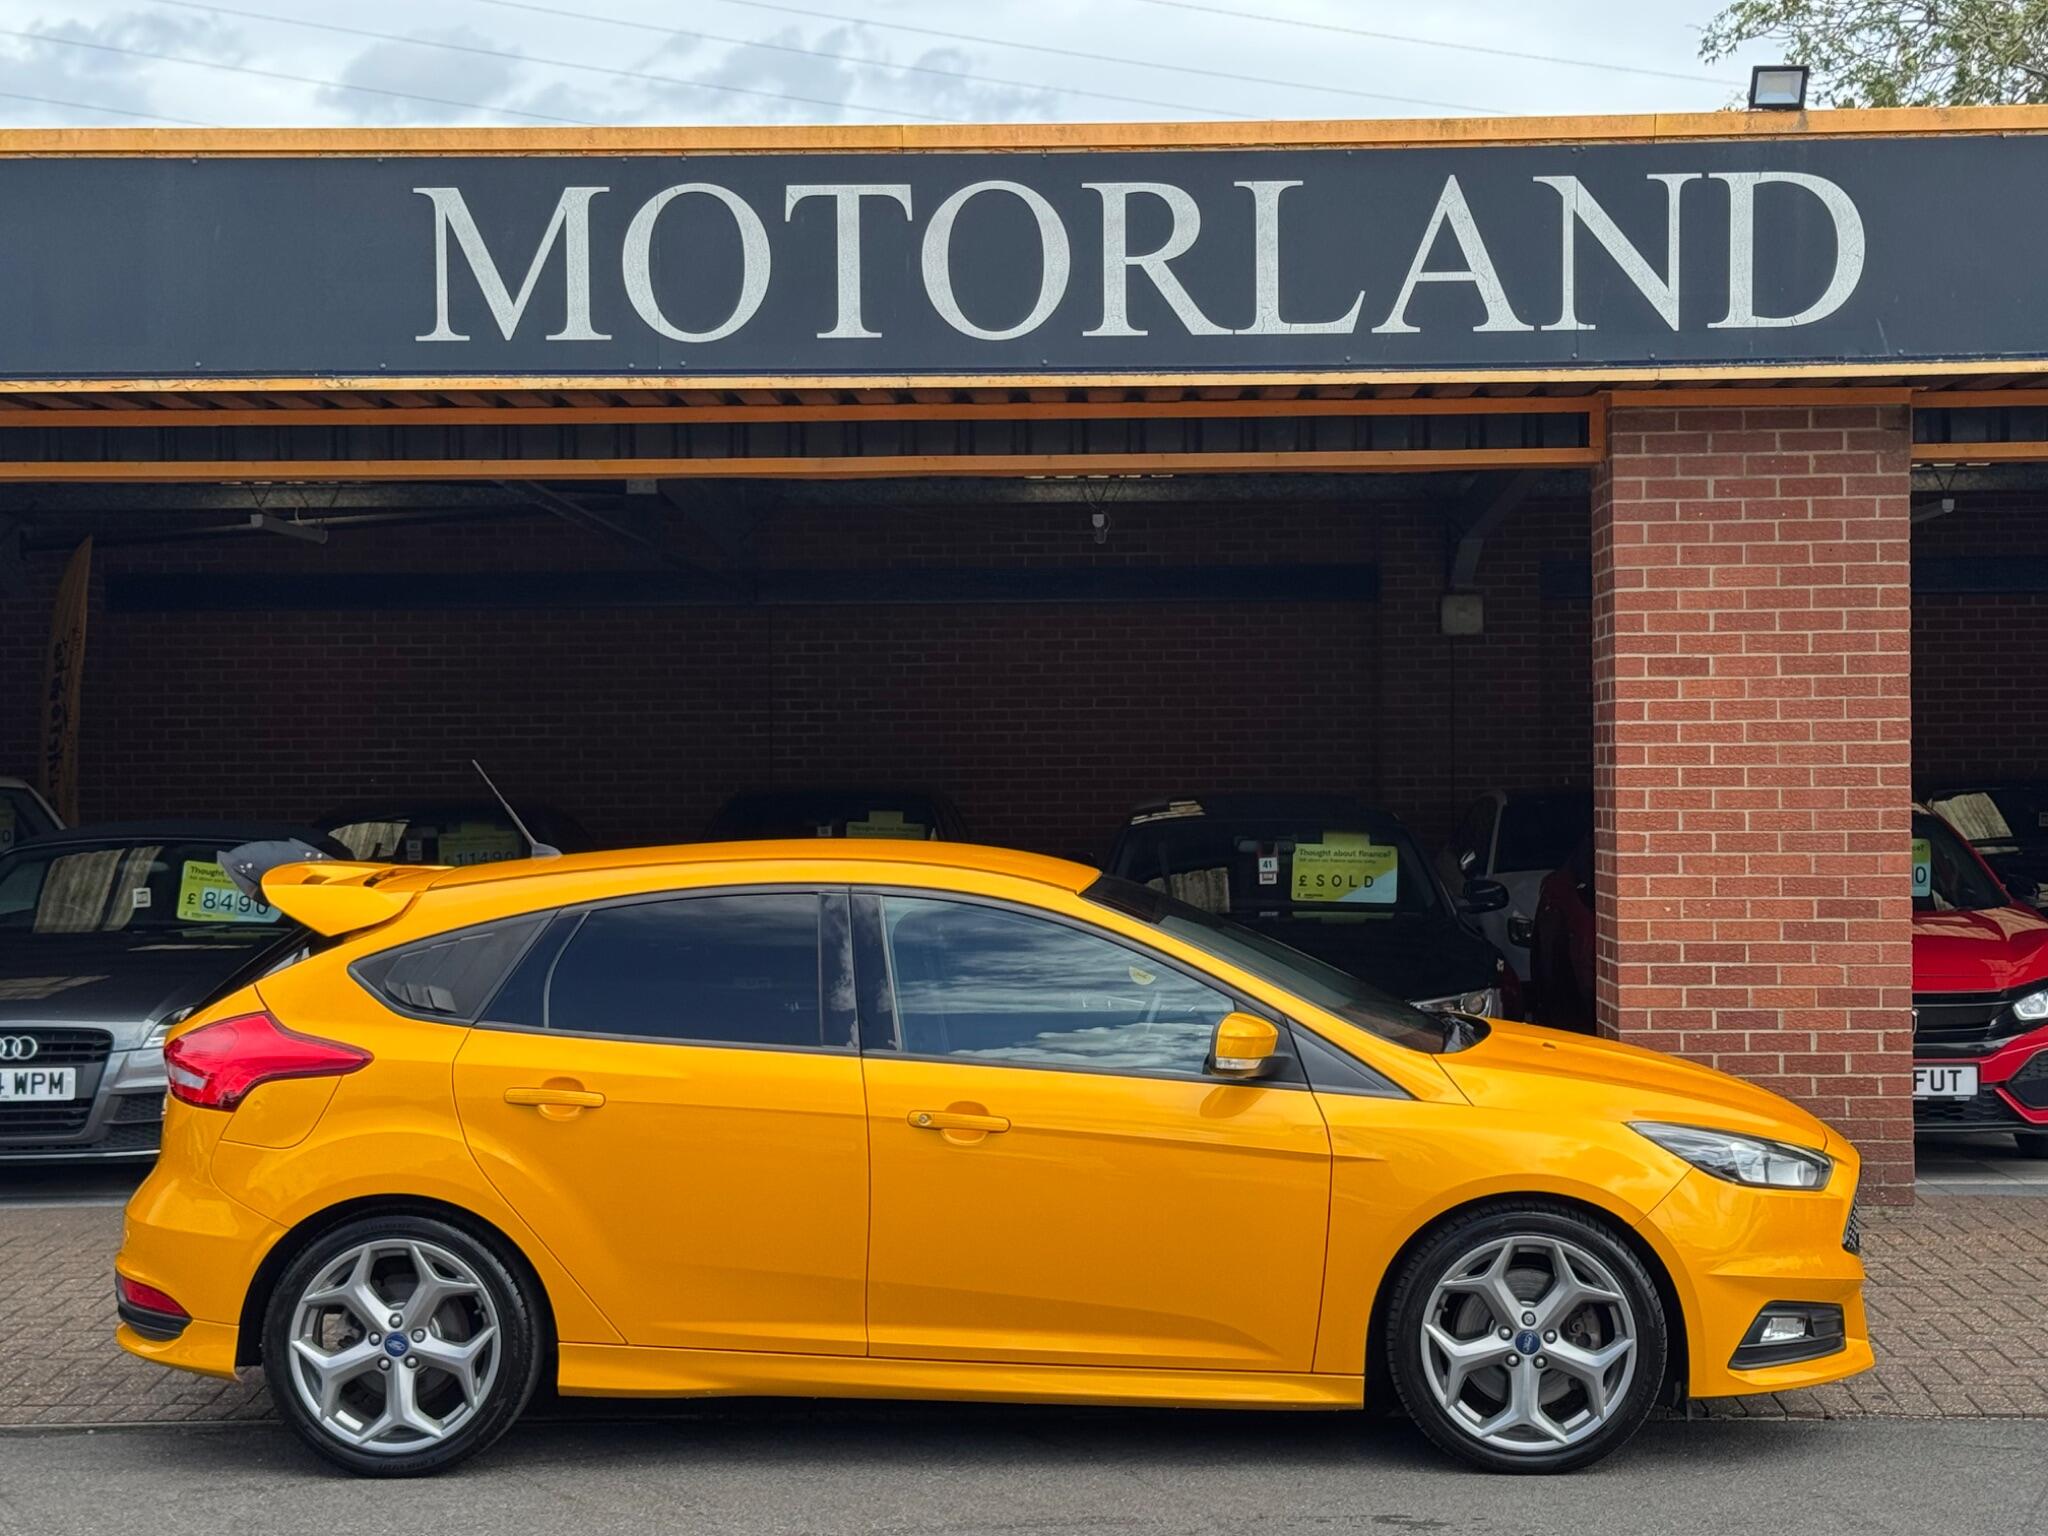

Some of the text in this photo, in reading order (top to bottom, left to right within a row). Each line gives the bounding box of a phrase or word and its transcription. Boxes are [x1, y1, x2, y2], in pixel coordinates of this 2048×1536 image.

[413, 171, 1865, 343] MOTORLAND
[1299, 848, 1331, 858] Thought
[1334, 848, 1356, 857] about
[190, 865, 225, 877] Thought
[1316, 874, 1374, 888] SOLD
[186, 893, 197, 905] £
[14, 1072, 64, 1095] WPM
[1913, 1070, 1962, 1091] FUT
